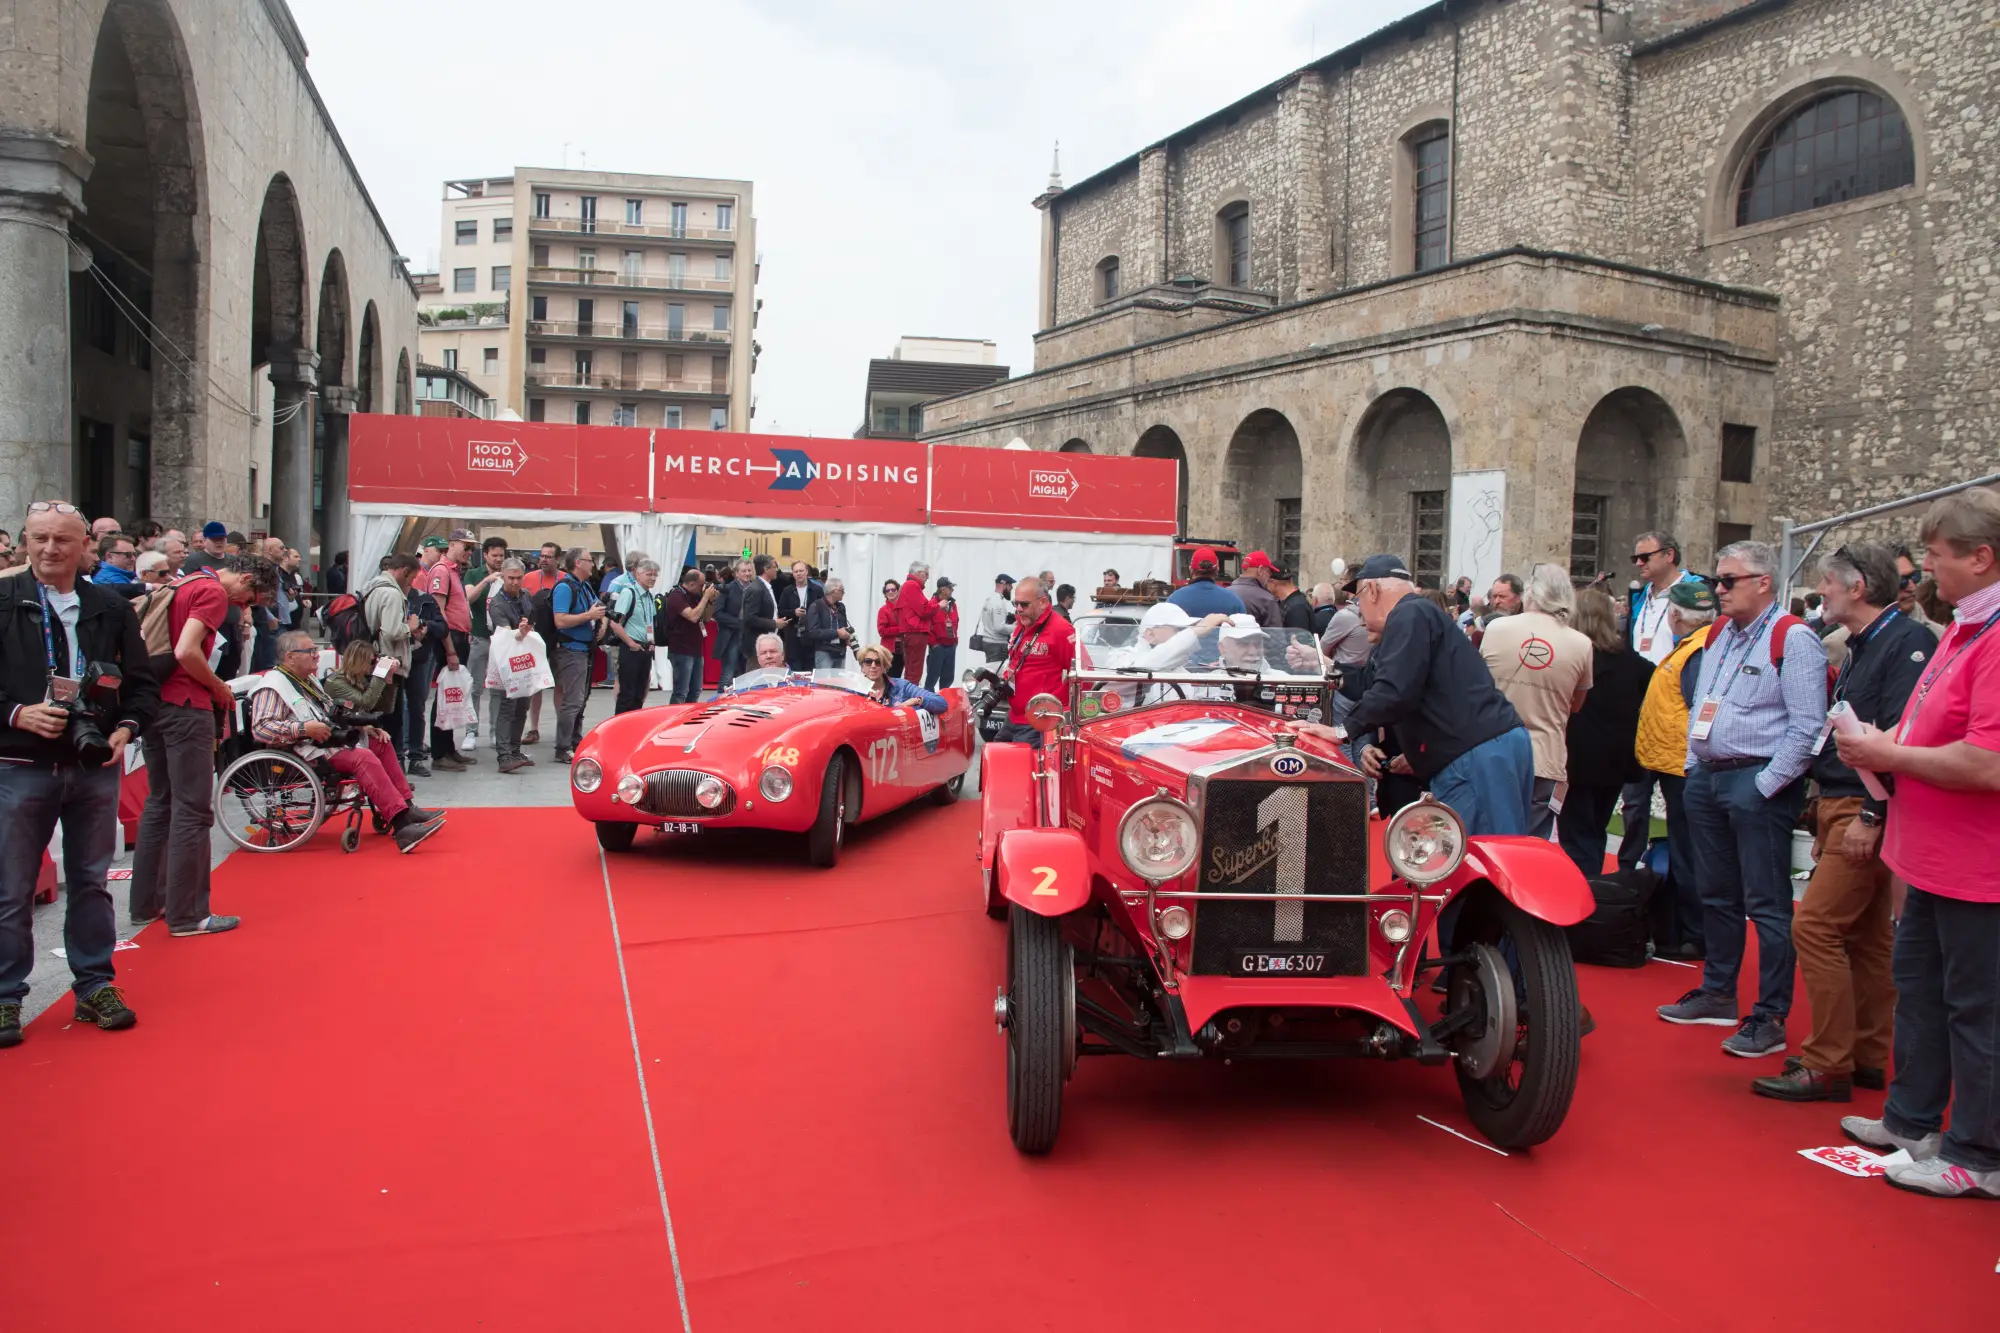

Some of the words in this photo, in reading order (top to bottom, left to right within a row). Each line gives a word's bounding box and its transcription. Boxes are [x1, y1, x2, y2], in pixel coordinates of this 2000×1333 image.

[474, 444, 512, 456] 1000
[471, 457, 514, 469] MIGLIA
[664, 454, 919, 485] MERCHANDISING
[1035, 473, 1066, 484] 1000
[1032, 485, 1068, 496] MIGLIA
[921, 711, 937, 732] 148
[762, 746, 800, 767] 148
[868, 735, 899, 788] 172
[1277, 760, 1301, 772] OM
[664, 822, 699, 834] DZ-18-11
[1207, 826, 1285, 886] Superba
[1256, 785, 1309, 942] 1
[1030, 866, 1059, 897] 2
[1242, 955, 1270, 972] GE
[1285, 955, 1325, 972] 6307
